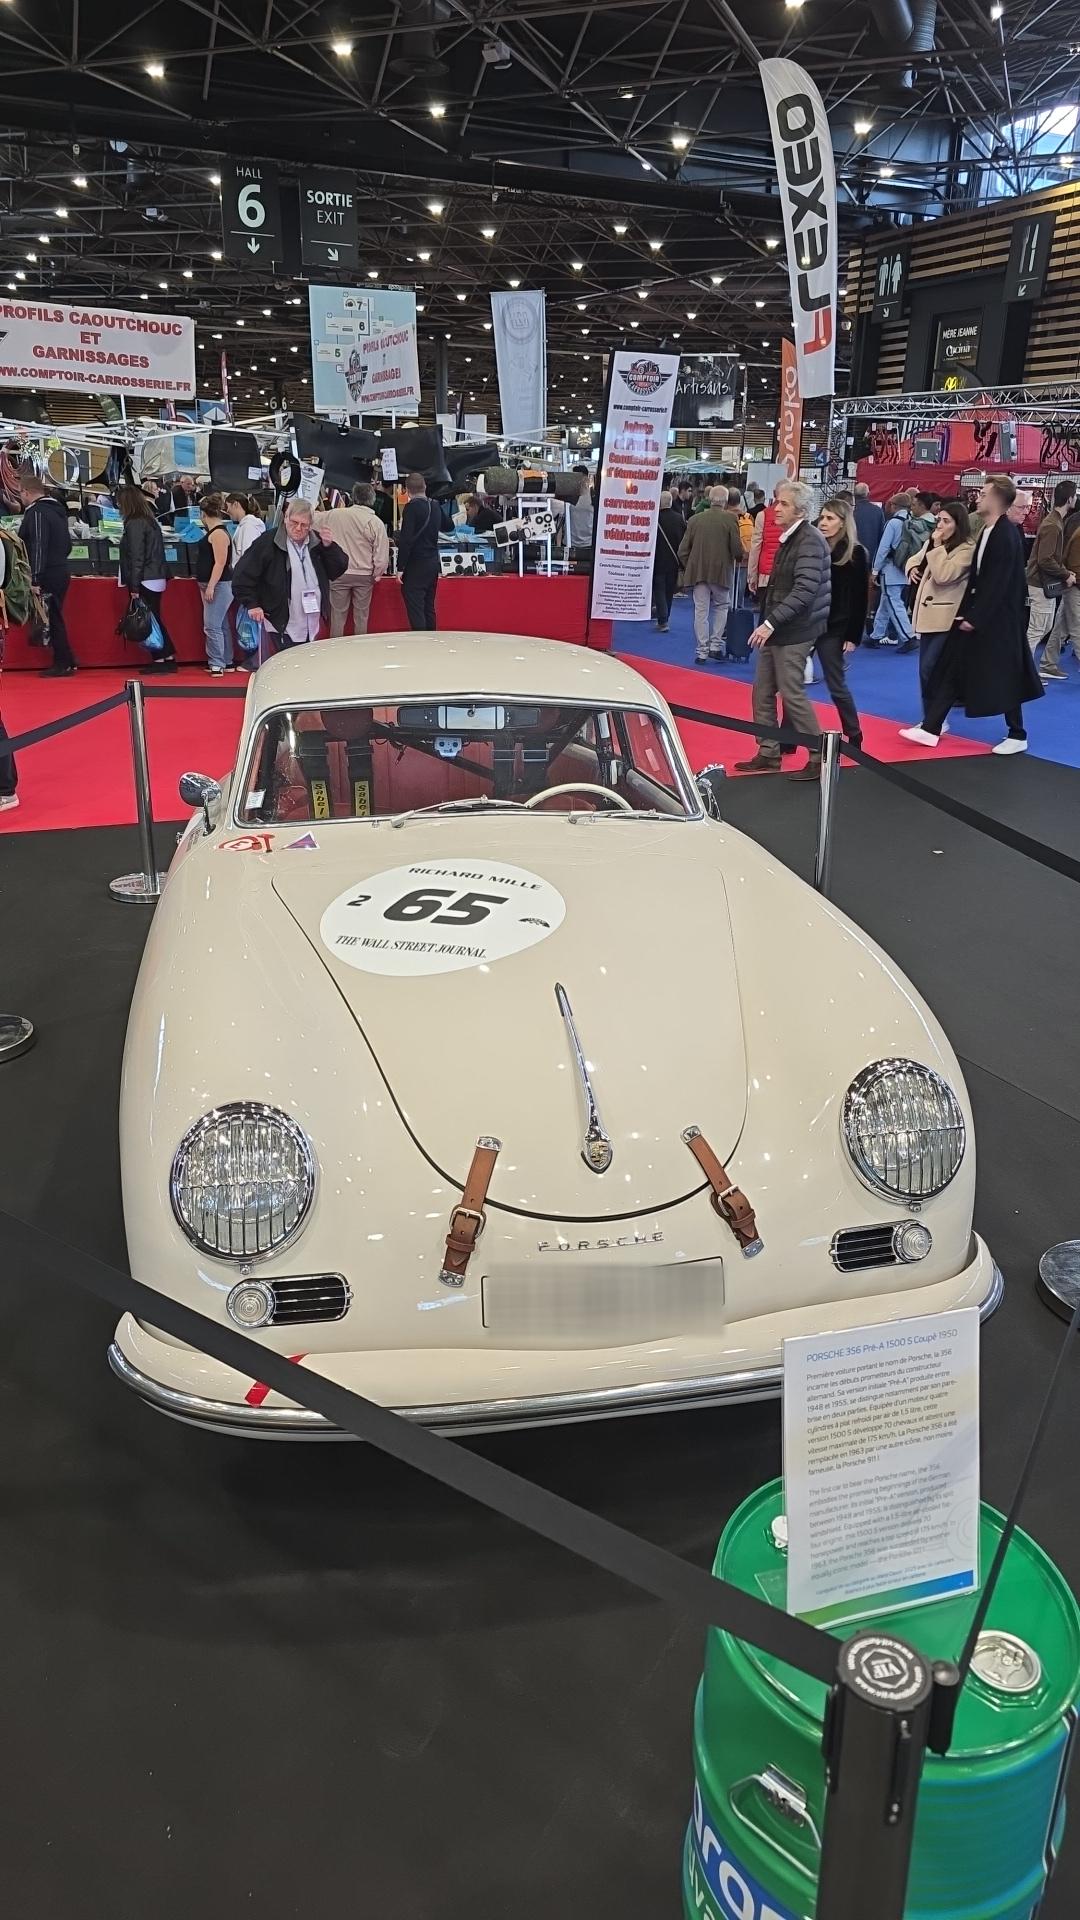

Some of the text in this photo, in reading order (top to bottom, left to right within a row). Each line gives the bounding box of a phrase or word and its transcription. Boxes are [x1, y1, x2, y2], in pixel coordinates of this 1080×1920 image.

[236, 166, 263, 180] HALL
[238, 184, 266, 228] 6
[306, 190, 353, 208] SORTIE
[317, 210, 345, 226] EXIT
[0, 304, 183, 336] ROFILS CAOUTCHOUC
[80, 331, 102, 345] ET
[957, 326, 978, 338] JEANNE
[32, 345, 150, 369] GARNISSAGES
[269, 396, 278, 410] 6
[281, 396, 288, 411] 6
[605, 513, 651, 527] pour tous
[604, 527, 650, 543] véhicules
[314, 783, 326, 818] Sabel
[408, 867, 543, 891] RICHARD MILLE
[346, 895, 372, 907] 2
[383, 888, 511, 926] 65
[336, 935, 359, 946] THE
[360, 937, 390, 950] WALL
[390, 940, 438, 953] STREET
[807, 1329, 958, 1363] PORSCHE 356 Pré-A 1500 S Coupé 1950
[807, 1370, 834, 1381] Première
[835, 1366, 856, 1376] voiture
[857, 1362, 878, 1373] portant
[940, 1349, 952, 1357] 356
[906, 1361, 942, 1373] constructeur
[846, 1385, 867, 1395] version
[910, 1373, 934, 1384] produite
[807, 1404, 823, 1412] 1948
[858, 1392, 884, 1404] distingue
[920, 1385, 929, 1393] par
[832, 1410, 846, 1418] deux
[808, 1423, 834, 1435] cylindres
[808, 1434, 829, 1444] version
[831, 1431, 846, 1439] 1500
[893, 1417, 918, 1427] chevaux
[867, 1435, 878, 1443] 175
[906, 1425, 929, 1435] Porsche
[931, 1422, 942, 1430] 356
[849, 1448, 864, 1457] 1963
[865, 1447, 875, 1455] par
[842, 1458, 866, 1469] Porsche
